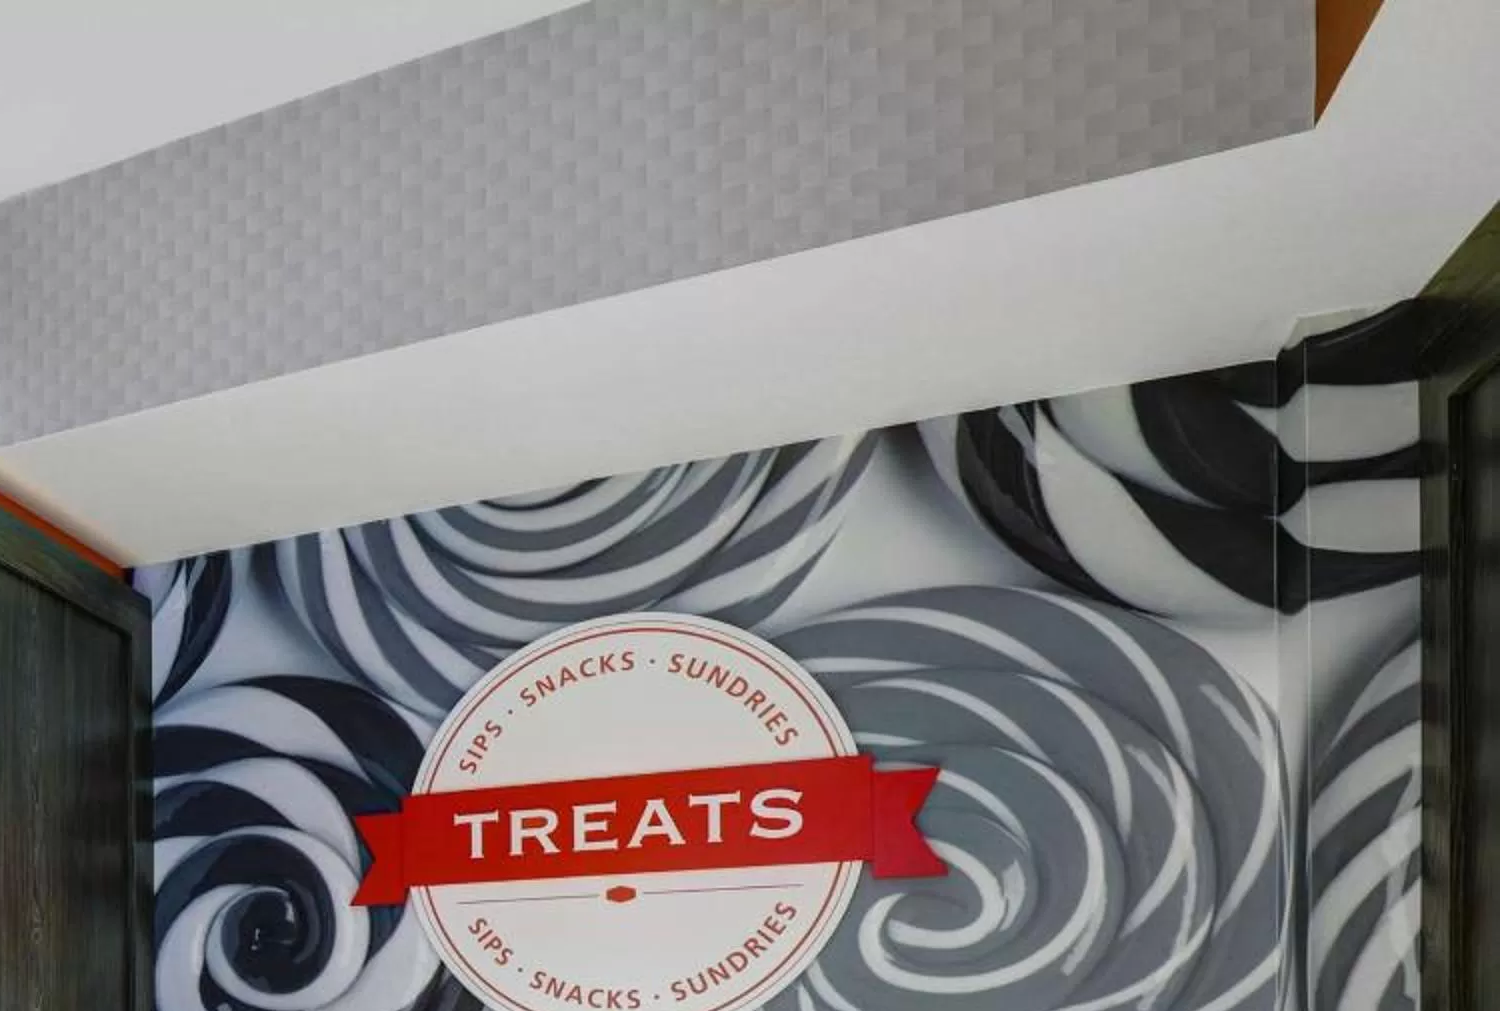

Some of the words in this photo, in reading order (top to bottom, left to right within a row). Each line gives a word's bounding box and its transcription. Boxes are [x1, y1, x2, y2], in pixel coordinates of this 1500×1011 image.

[458, 719, 503, 775] SIPS
[518, 650, 636, 708] SNACKS
[667, 652, 800, 748] SUNDRIES
[453, 788, 805, 860] TREATS
[467, 916, 514, 967] SIPS
[527, 970, 642, 1010] SNACKS
[671, 900, 798, 1001] SUNDRIES
